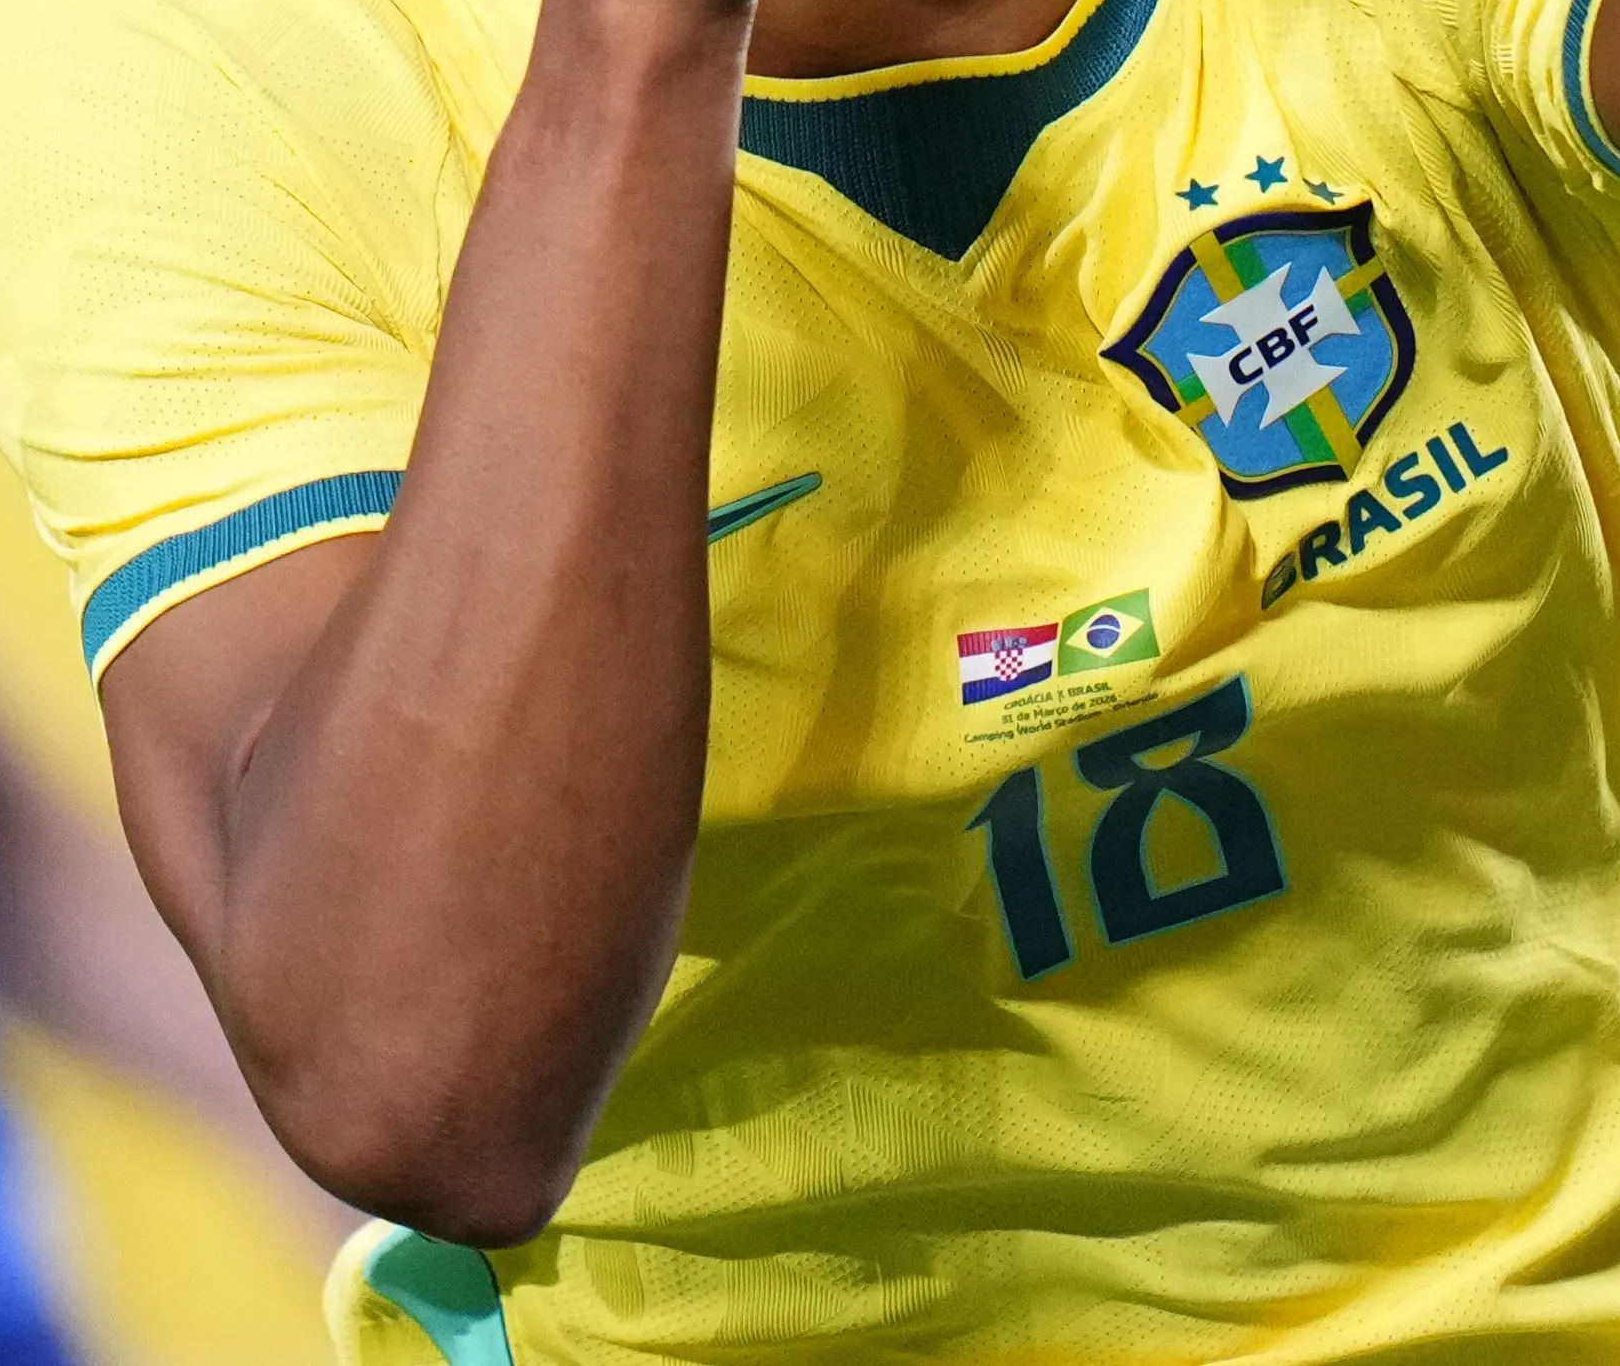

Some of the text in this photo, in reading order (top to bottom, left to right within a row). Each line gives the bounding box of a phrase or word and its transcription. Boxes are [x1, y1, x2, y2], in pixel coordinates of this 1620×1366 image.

[1227, 303, 1320, 386] CBF
[1068, 682, 1113, 697] BRASIL
[1017, 712, 1030, 721] de
[1033, 706, 1069, 719] Março
[1071, 702, 1086, 711] de
[964, 730, 1014, 743] Camping
[1017, 721, 1052, 735] World
[964, 671, 1289, 982] 18
